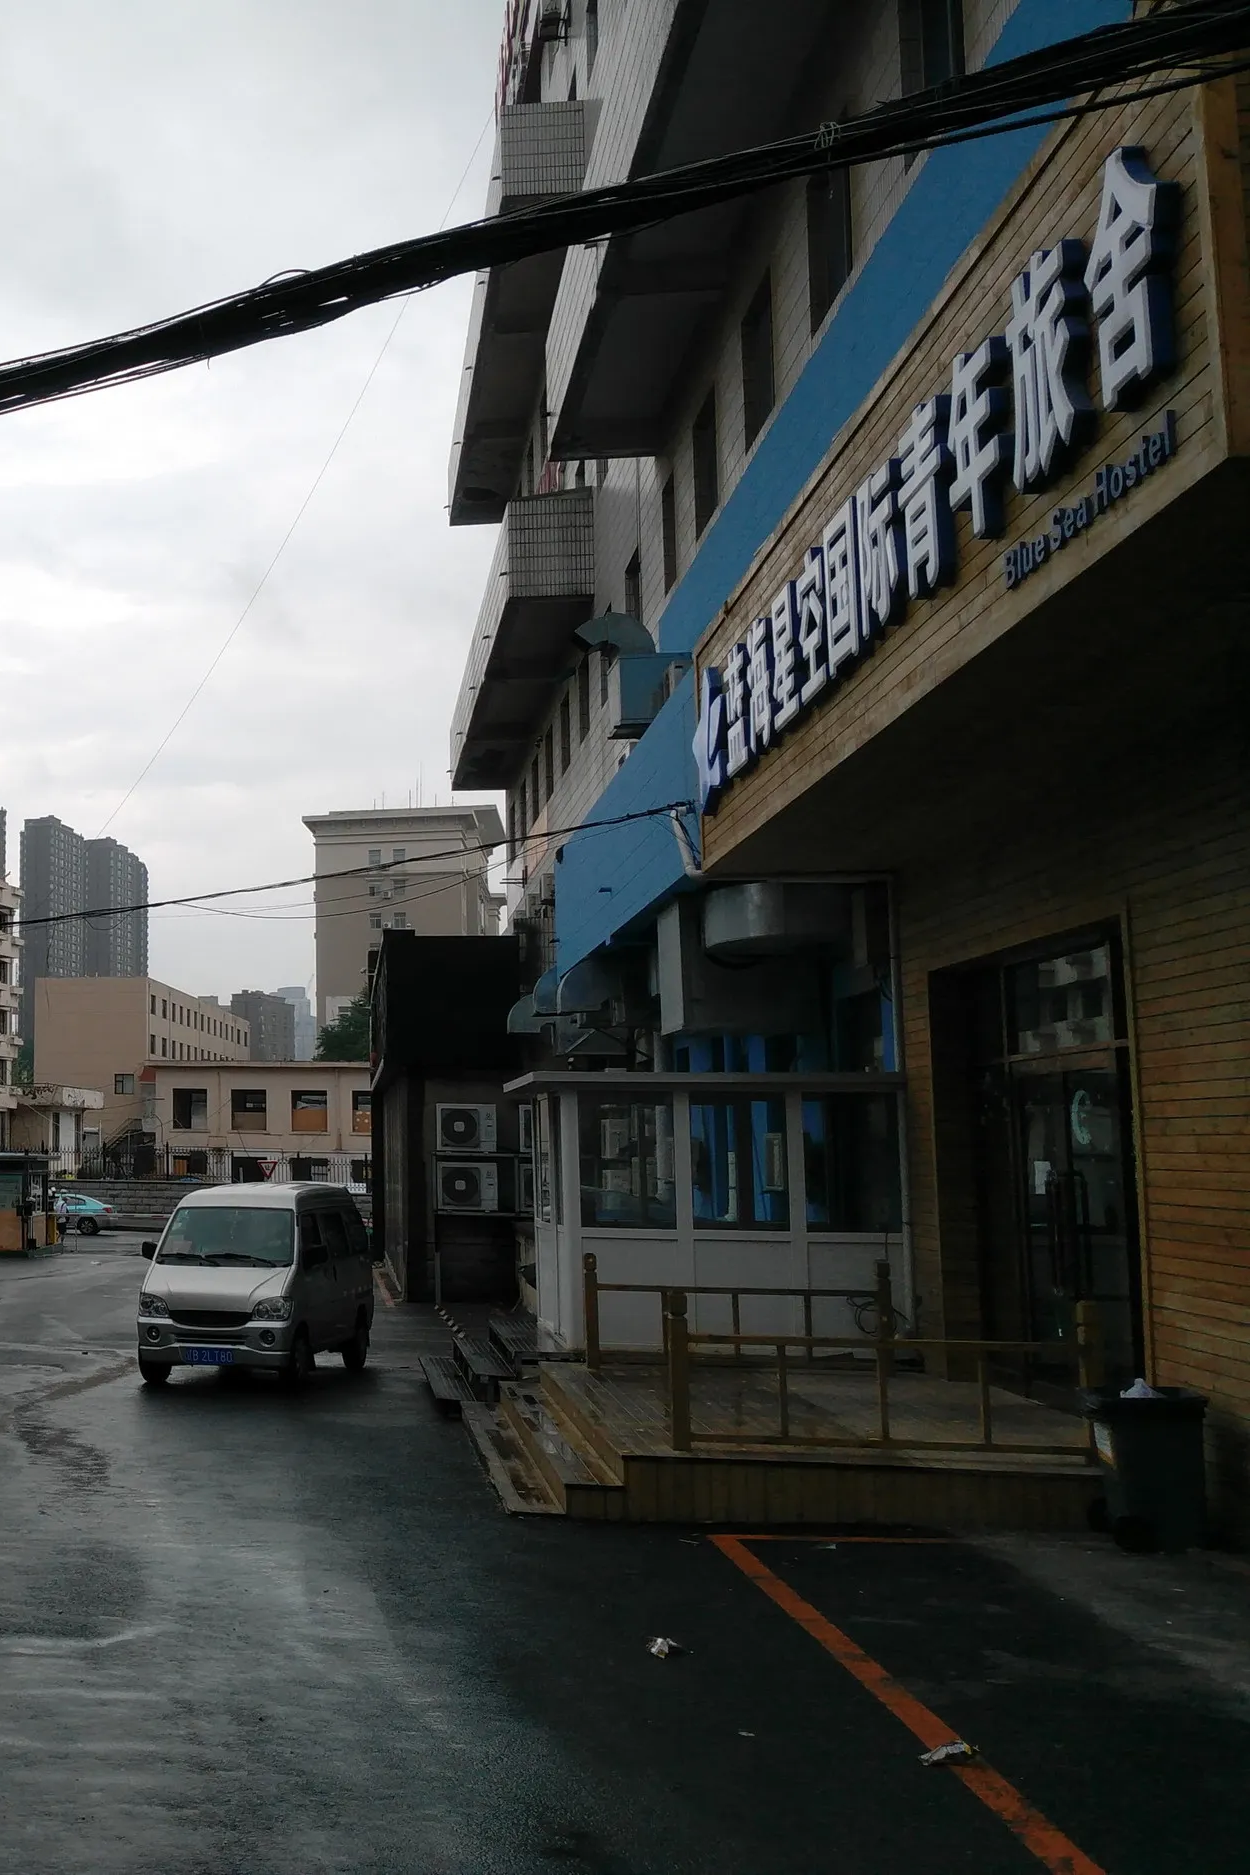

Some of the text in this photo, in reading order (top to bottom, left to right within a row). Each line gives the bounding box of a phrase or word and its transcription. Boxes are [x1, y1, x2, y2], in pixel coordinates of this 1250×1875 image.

[723, 146, 1176, 779] 蓝海星空国际青年旅舍
[1004, 410, 1176, 589] Blue Sea Hostel
